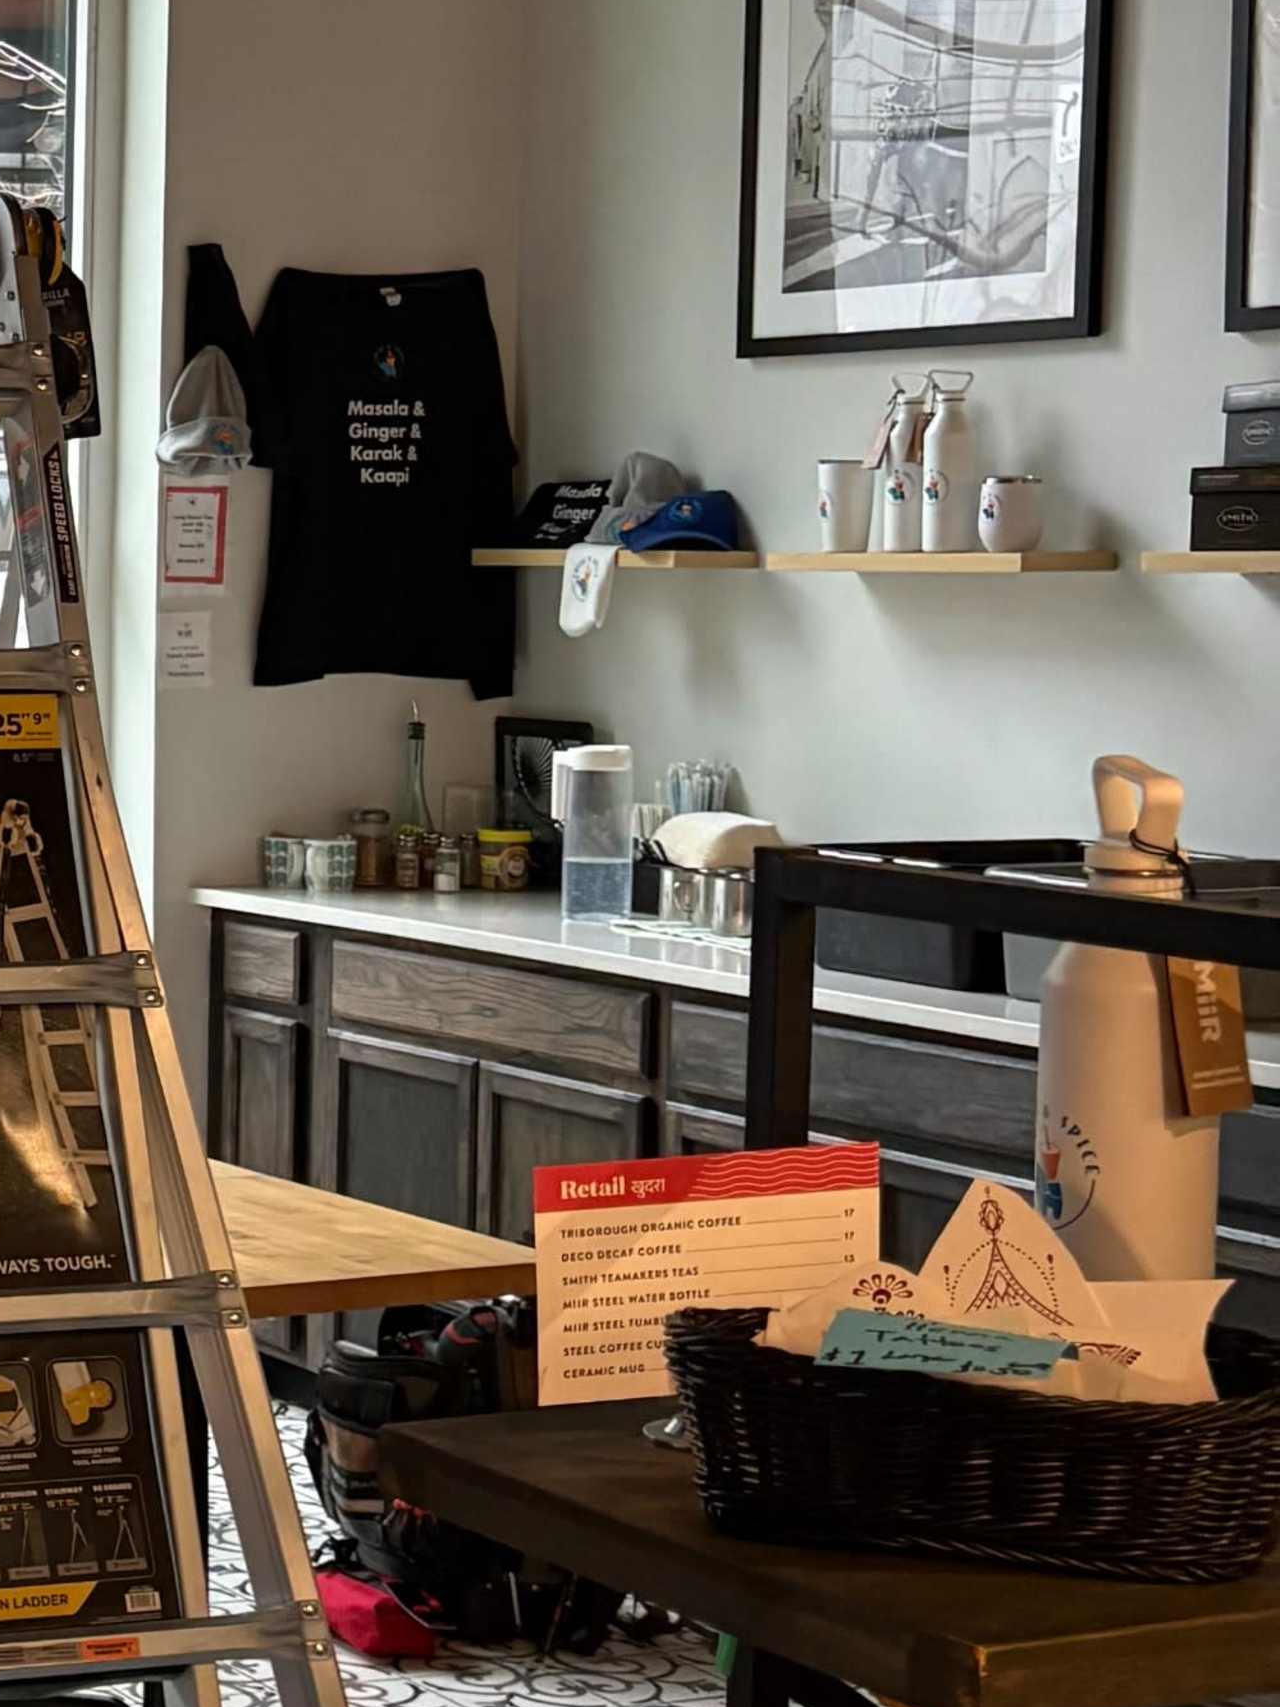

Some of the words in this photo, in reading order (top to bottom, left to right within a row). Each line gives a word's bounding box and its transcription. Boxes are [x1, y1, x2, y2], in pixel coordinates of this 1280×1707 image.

[347, 399, 409, 416] Masala
[413, 401, 425, 416] &
[348, 422, 406, 442] Ginger
[410, 424, 421, 439] &
[350, 444, 403, 461] Karak
[407, 446, 417, 461] &
[48, 460, 65, 501] LOCKS
[360, 467, 409, 486] Kaapi
[53, 502, 70, 543] SPEED
[560, 1175, 625, 1200] Retail
[561, 1225, 638, 1239] TRIBOROUGH
[641, 1220, 694, 1233] ORGANIC
[697, 1216, 742, 1229] COFFEE
[561, 1251, 594, 1262] DECO
[597, 1248, 634, 1260] DECAF
[638, 1244, 682, 1257] COFFEE
[44, 1255, 112, 1273] TOUGH.
[562, 1274, 598, 1286] SMITH
[601, 1269, 669, 1283] TEAMAKERS
[671, 1267, 699, 1278] TEAS
[562, 1298, 590, 1310] MIIR
[592, 1295, 625, 1308] STEEL
[628, 1293, 667, 1306] WATER
[669, 1289, 710, 1302] BOTTLE
[562, 1321, 590, 1334] MIIR
[592, 1319, 625, 1331] STEEL
[562, 1344, 596, 1357] STEEL
[599, 1341, 643, 1355] COFFEE
[563, 1366, 616, 1380] CERAMIC
[619, 1364, 645, 1376] MUG
[14, 1594, 69, 1610] LADDER
